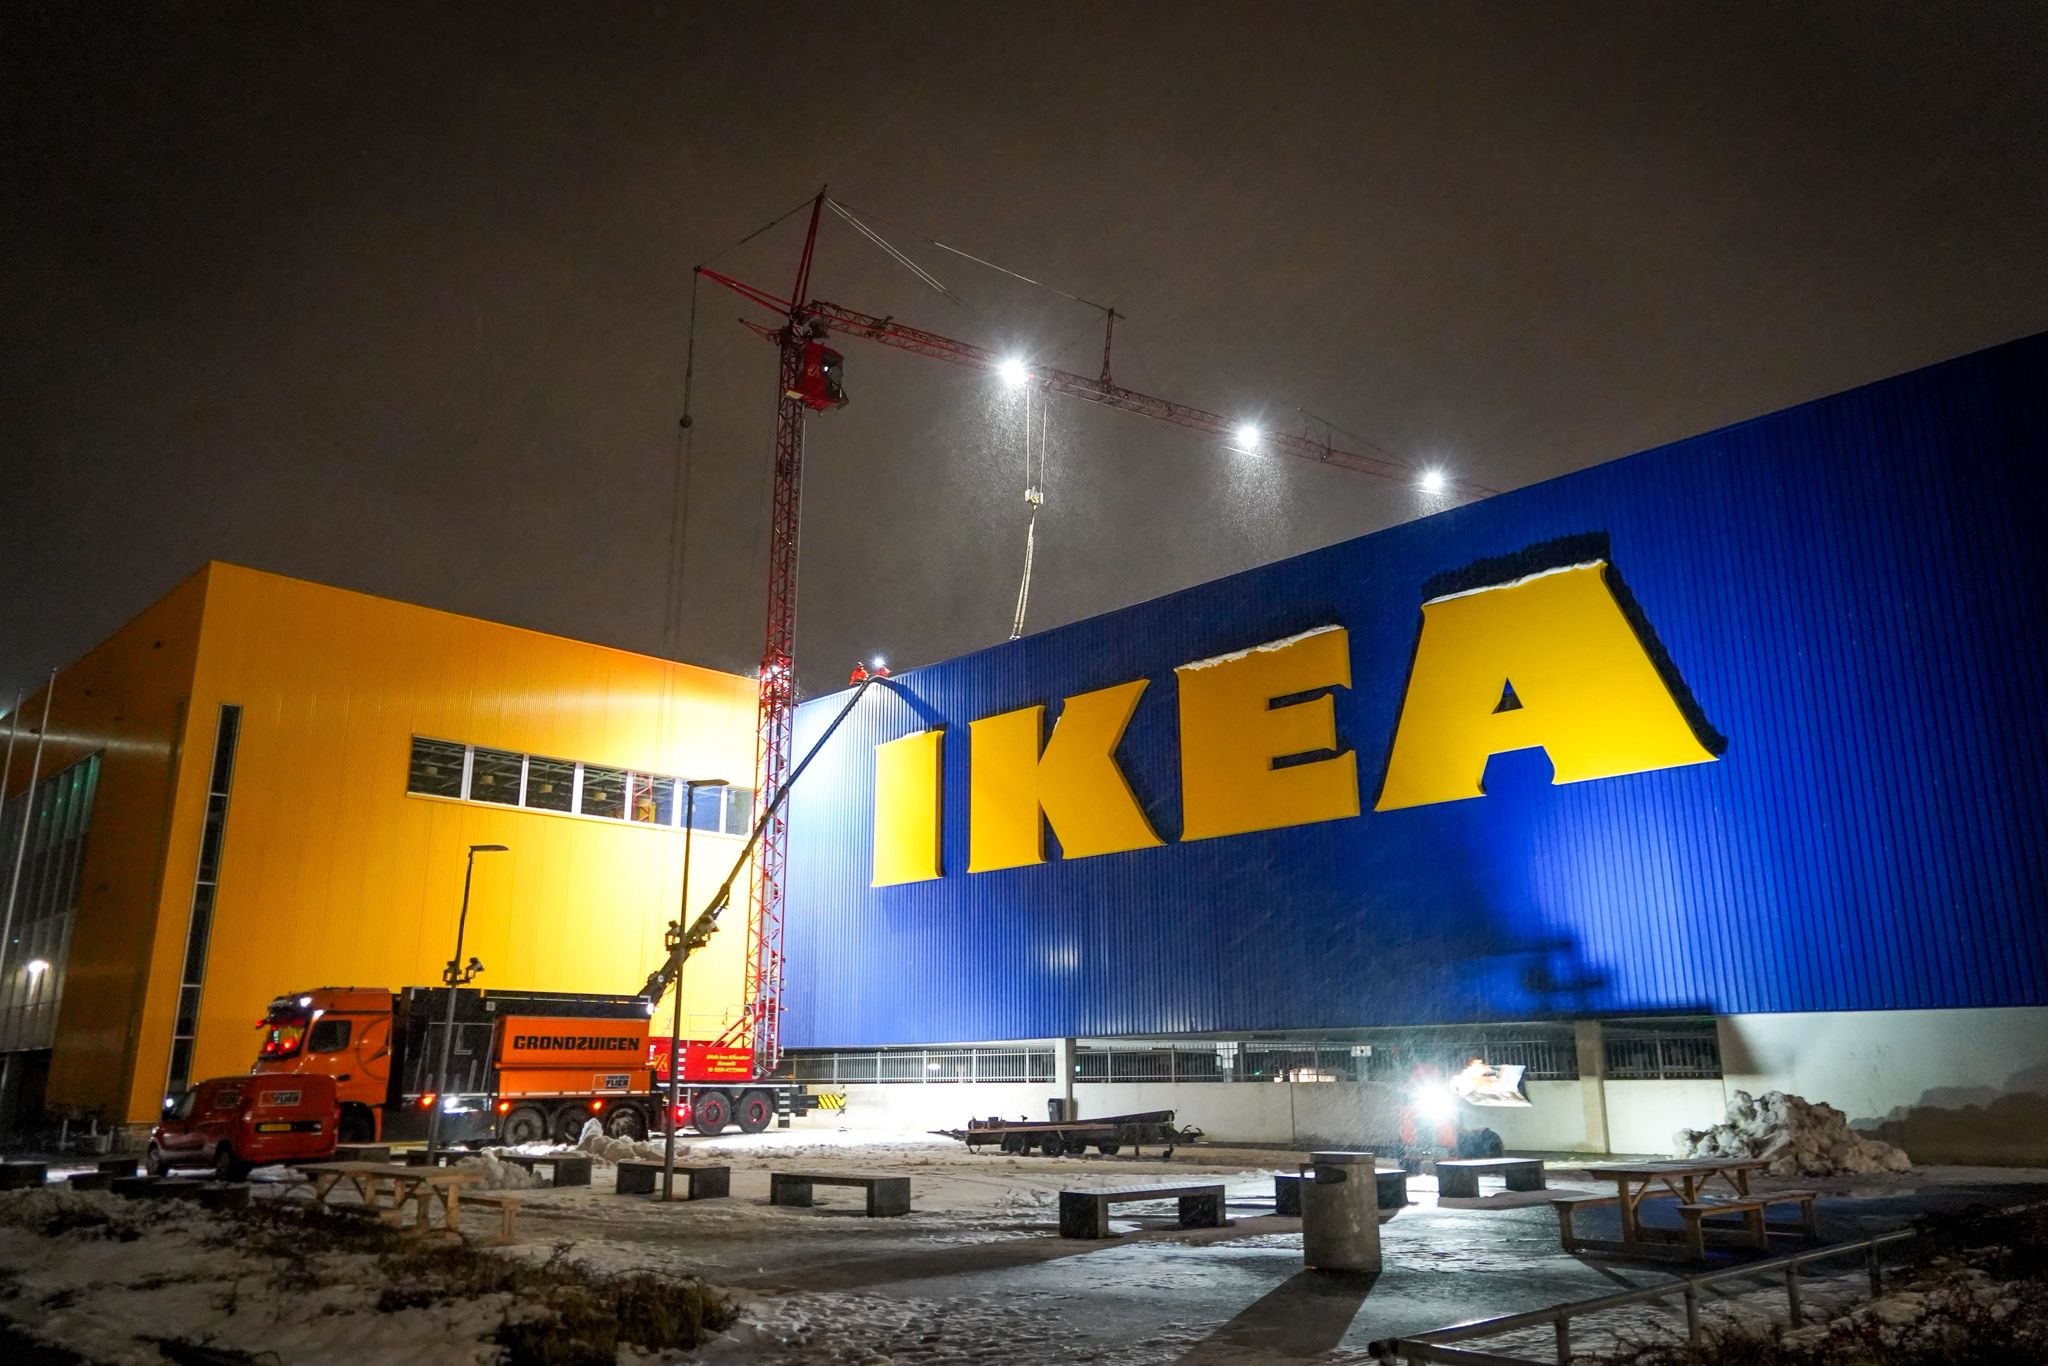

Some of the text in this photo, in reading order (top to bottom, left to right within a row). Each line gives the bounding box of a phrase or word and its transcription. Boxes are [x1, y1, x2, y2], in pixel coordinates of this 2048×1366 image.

[871, 559, 1720, 888] IKEA
[513, 1035, 640, 1051] GRONDZUIGEN
[606, 1079, 629, 1088] FLIER
